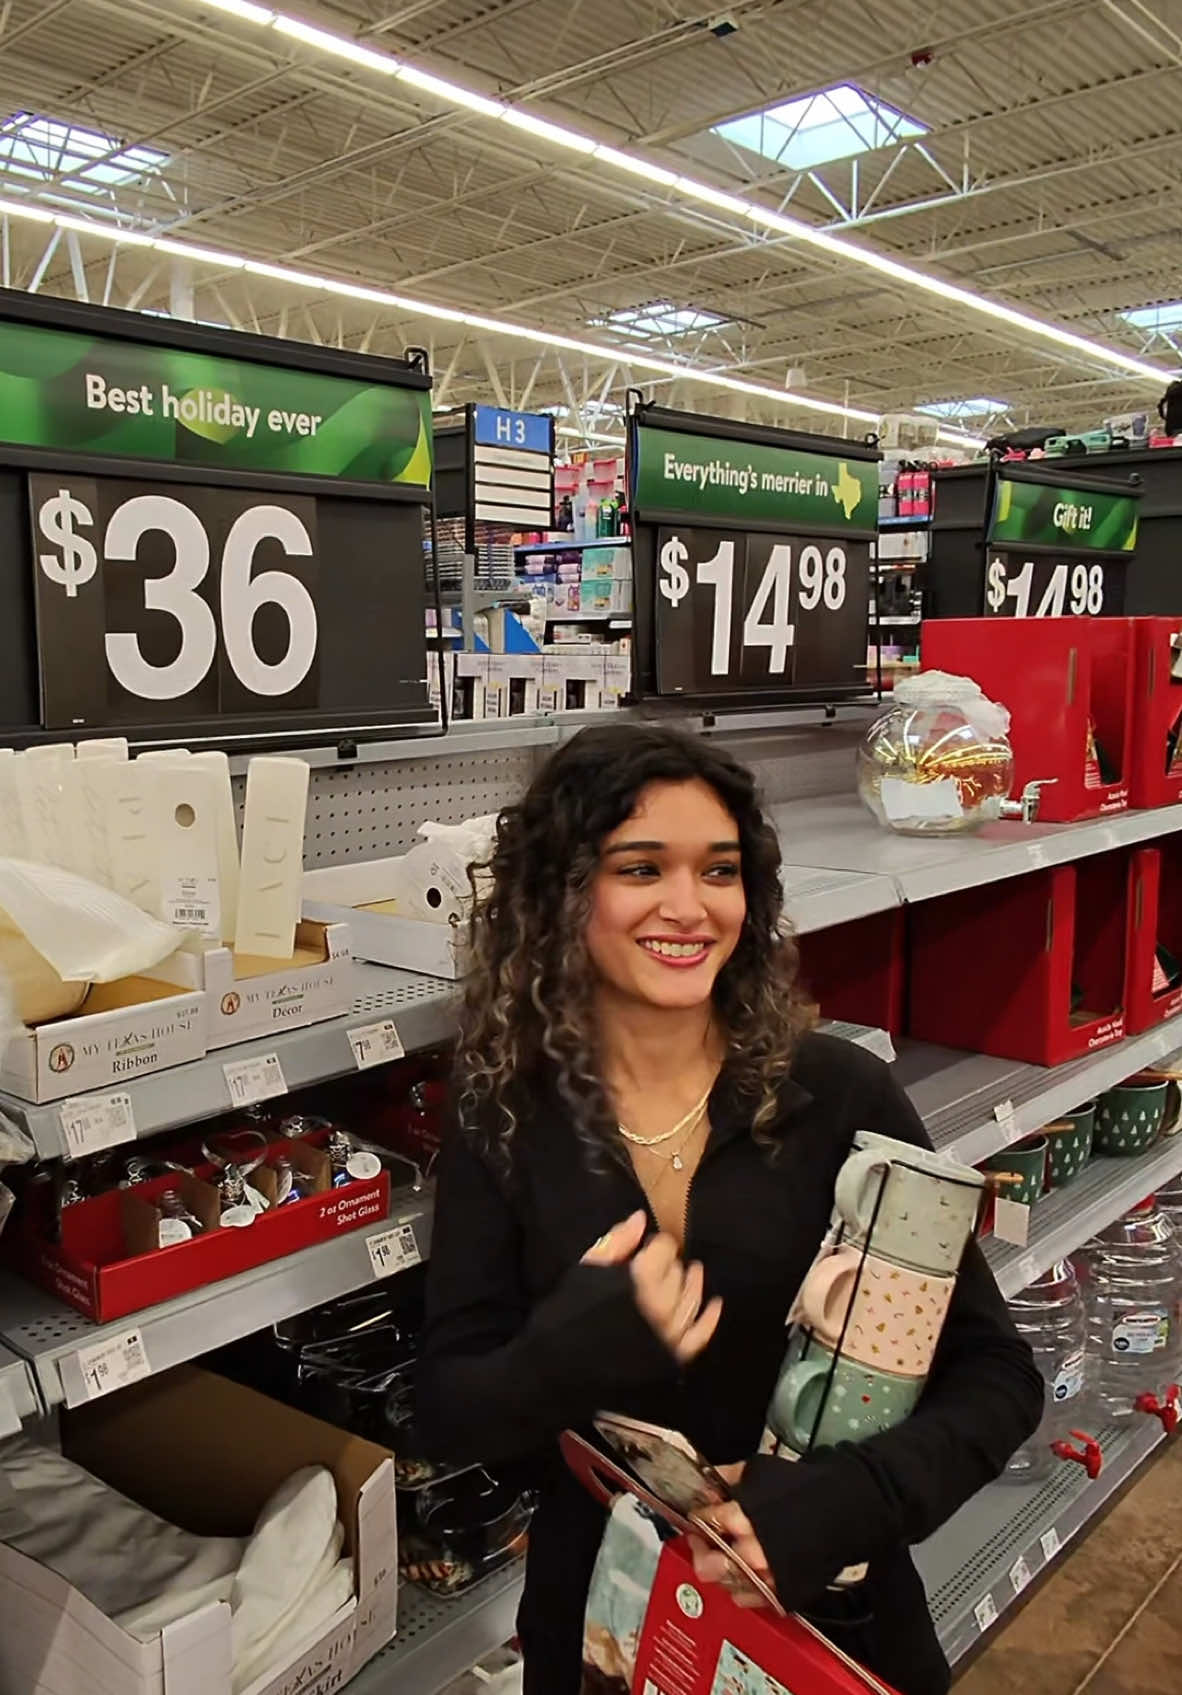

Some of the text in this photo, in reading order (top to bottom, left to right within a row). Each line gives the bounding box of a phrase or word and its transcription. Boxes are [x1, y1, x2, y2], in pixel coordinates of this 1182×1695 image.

[85, 373, 323, 438] Best holiday ever
[664, 453, 828, 497] Everything's merrier in
[1053, 502, 1093, 530] Gift it!
[39, 489, 318, 700] $36
[112, 1053, 158, 1075] Ribbon
[320, 1207, 326, 1218] 2
[338, 1189, 380, 1211] Ornament
[337, 1204, 380, 1225] Shot Glass
